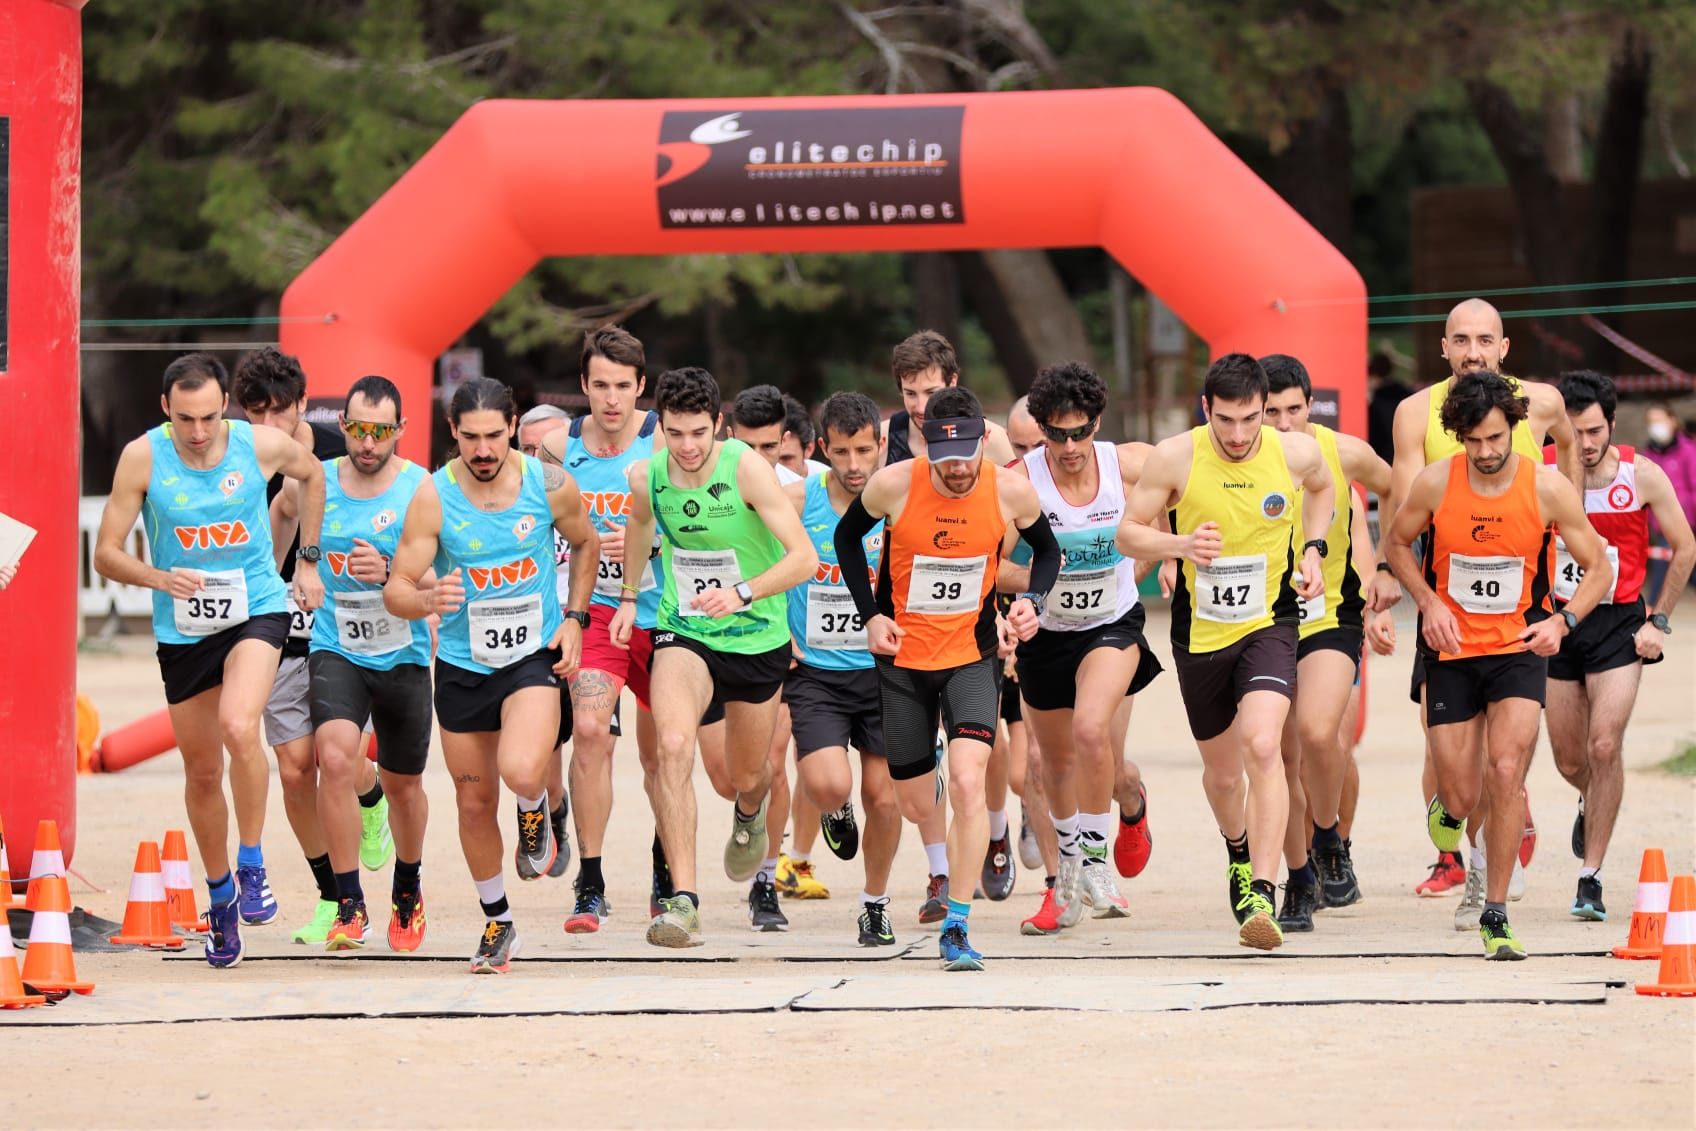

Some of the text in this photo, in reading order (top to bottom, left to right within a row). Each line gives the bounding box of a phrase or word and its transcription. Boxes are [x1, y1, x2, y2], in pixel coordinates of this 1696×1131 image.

[749, 138, 943, 166] elitechip
[935, 516, 959, 524] luanvi
[174, 519, 251, 550] VIVA
[467, 556, 539, 592] VIVA
[931, 581, 962, 600] 39
[1060, 589, 1104, 609] 337
[1211, 584, 1251, 607] 147
[1470, 580, 1500, 597] 40
[188, 597, 232, 619] 357
[346, 618, 390, 641] 382
[821, 613, 864, 633] 379
[485, 625, 528, 649] 348
